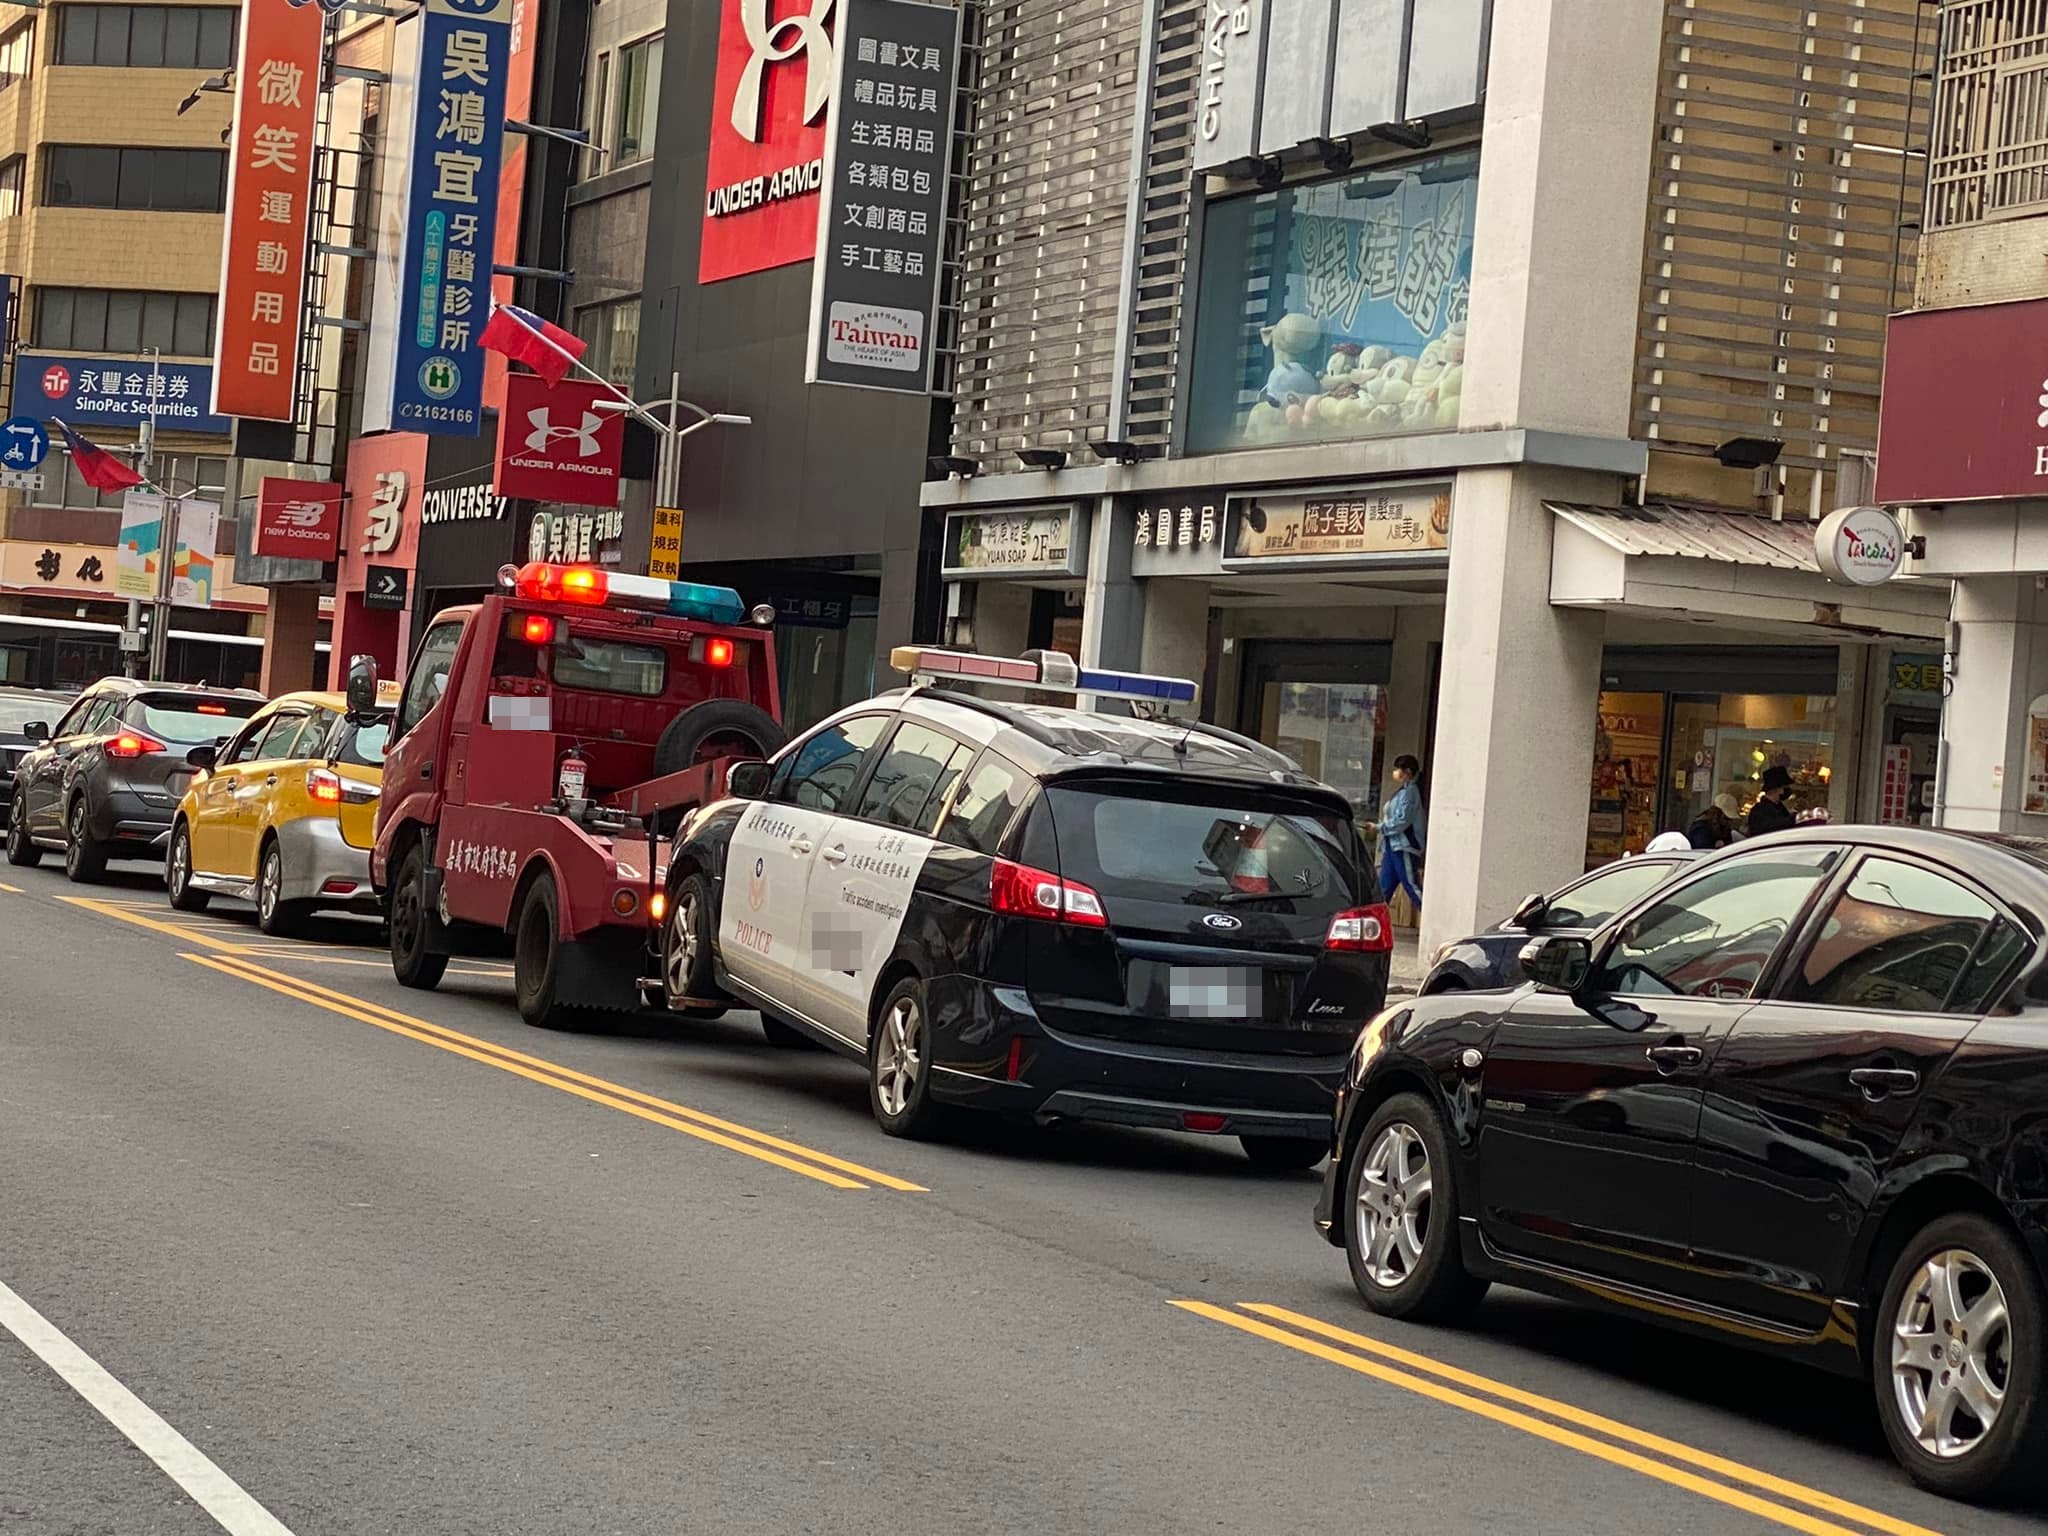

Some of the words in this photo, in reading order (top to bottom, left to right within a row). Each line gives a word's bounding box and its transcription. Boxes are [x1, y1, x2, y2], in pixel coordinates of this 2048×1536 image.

[857, 37, 941, 72] 圖書文具
[854, 79, 937, 113] 禮品玩具
[432, 29, 489, 204] 吳鴻宜
[850, 120, 935, 154] 生活用品
[848, 161, 931, 195] 各類包包
[706, 175, 765, 217] UNDER
[250, 58, 304, 376] 微笑運動用品
[843, 202, 928, 235] 文創商品
[840, 244, 924, 276] 手工藝品
[439, 213, 479, 353] 牙醫診所
[831, 319, 918, 351] Taiwan
[78, 369, 190, 399] 永豐金證券
[75, 396, 128, 414] SinoPac
[132, 399, 199, 418] Securities
[414, 404, 473, 423] 2162166
[509, 457, 554, 470] UNDER
[556, 461, 613, 477] ARMOUR
[421, 484, 493, 525] CONVERSE
[1304, 502, 1365, 535] 梳子專家
[264, 527, 286, 536] new
[287, 527, 331, 541] balance
[548, 512, 593, 564] 吳鴻宜
[1134, 505, 1215, 546] 鴻圖書局
[1283, 523, 1299, 548] 2F
[987, 550, 1006, 564] YUAN
[1007, 549, 1027, 563] SOAP
[1031, 534, 1049, 561] 2F
[35, 549, 104, 582] 彰化
[1894, 663, 1945, 692] 文具
[735, 919, 773, 954] POLICE
